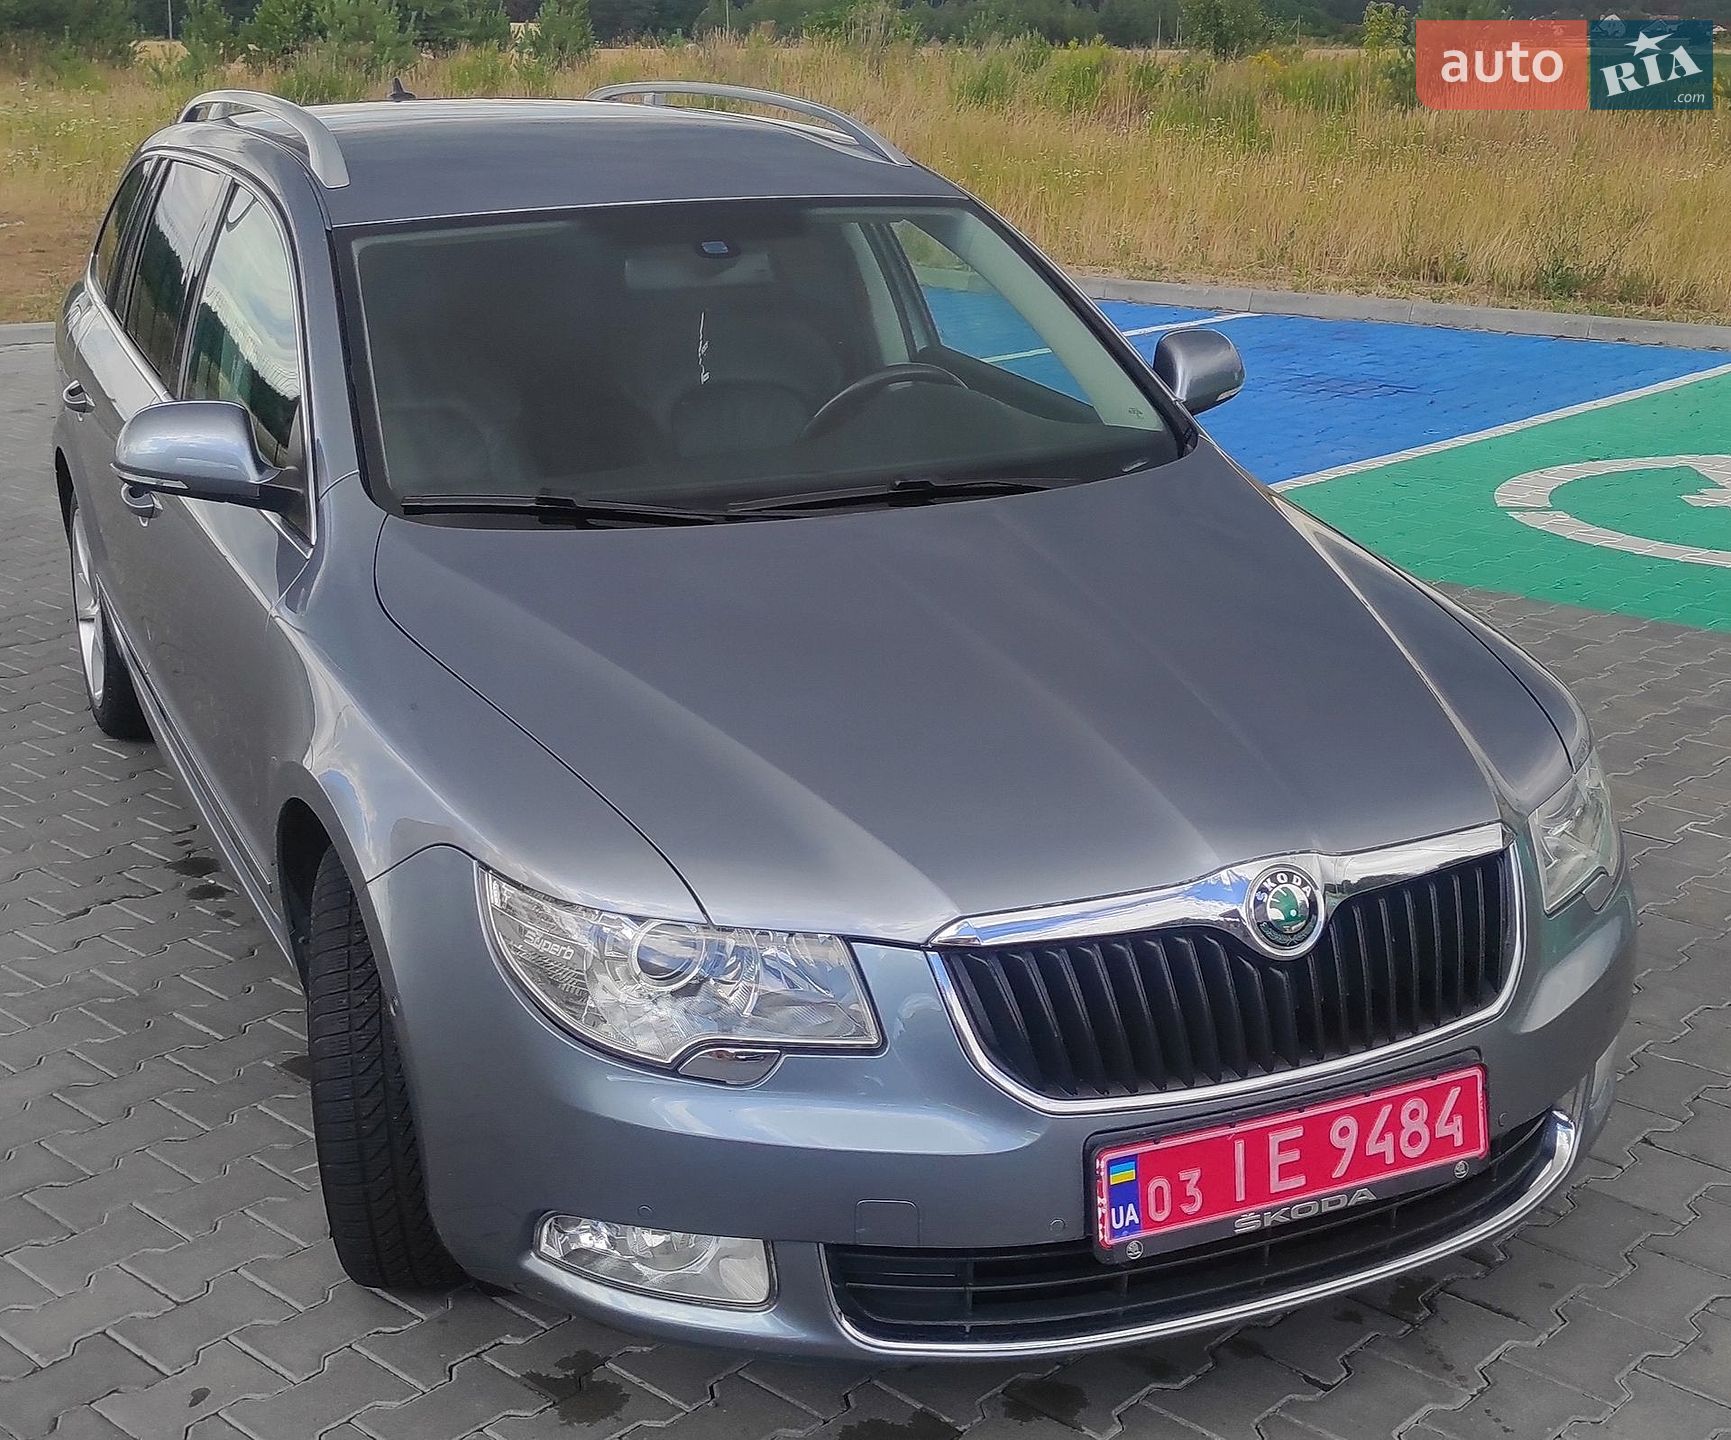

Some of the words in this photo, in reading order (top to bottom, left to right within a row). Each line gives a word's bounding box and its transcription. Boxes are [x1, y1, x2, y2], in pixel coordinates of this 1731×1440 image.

[524, 930, 574, 960] Superb
[1147, 1166, 1203, 1222] 03
[1233, 1126, 1307, 1202] IE
[1329, 1086, 1464, 1179] 9484
[1111, 1203, 1139, 1229] UA
[1233, 1187, 1377, 1234] ŠKODA
